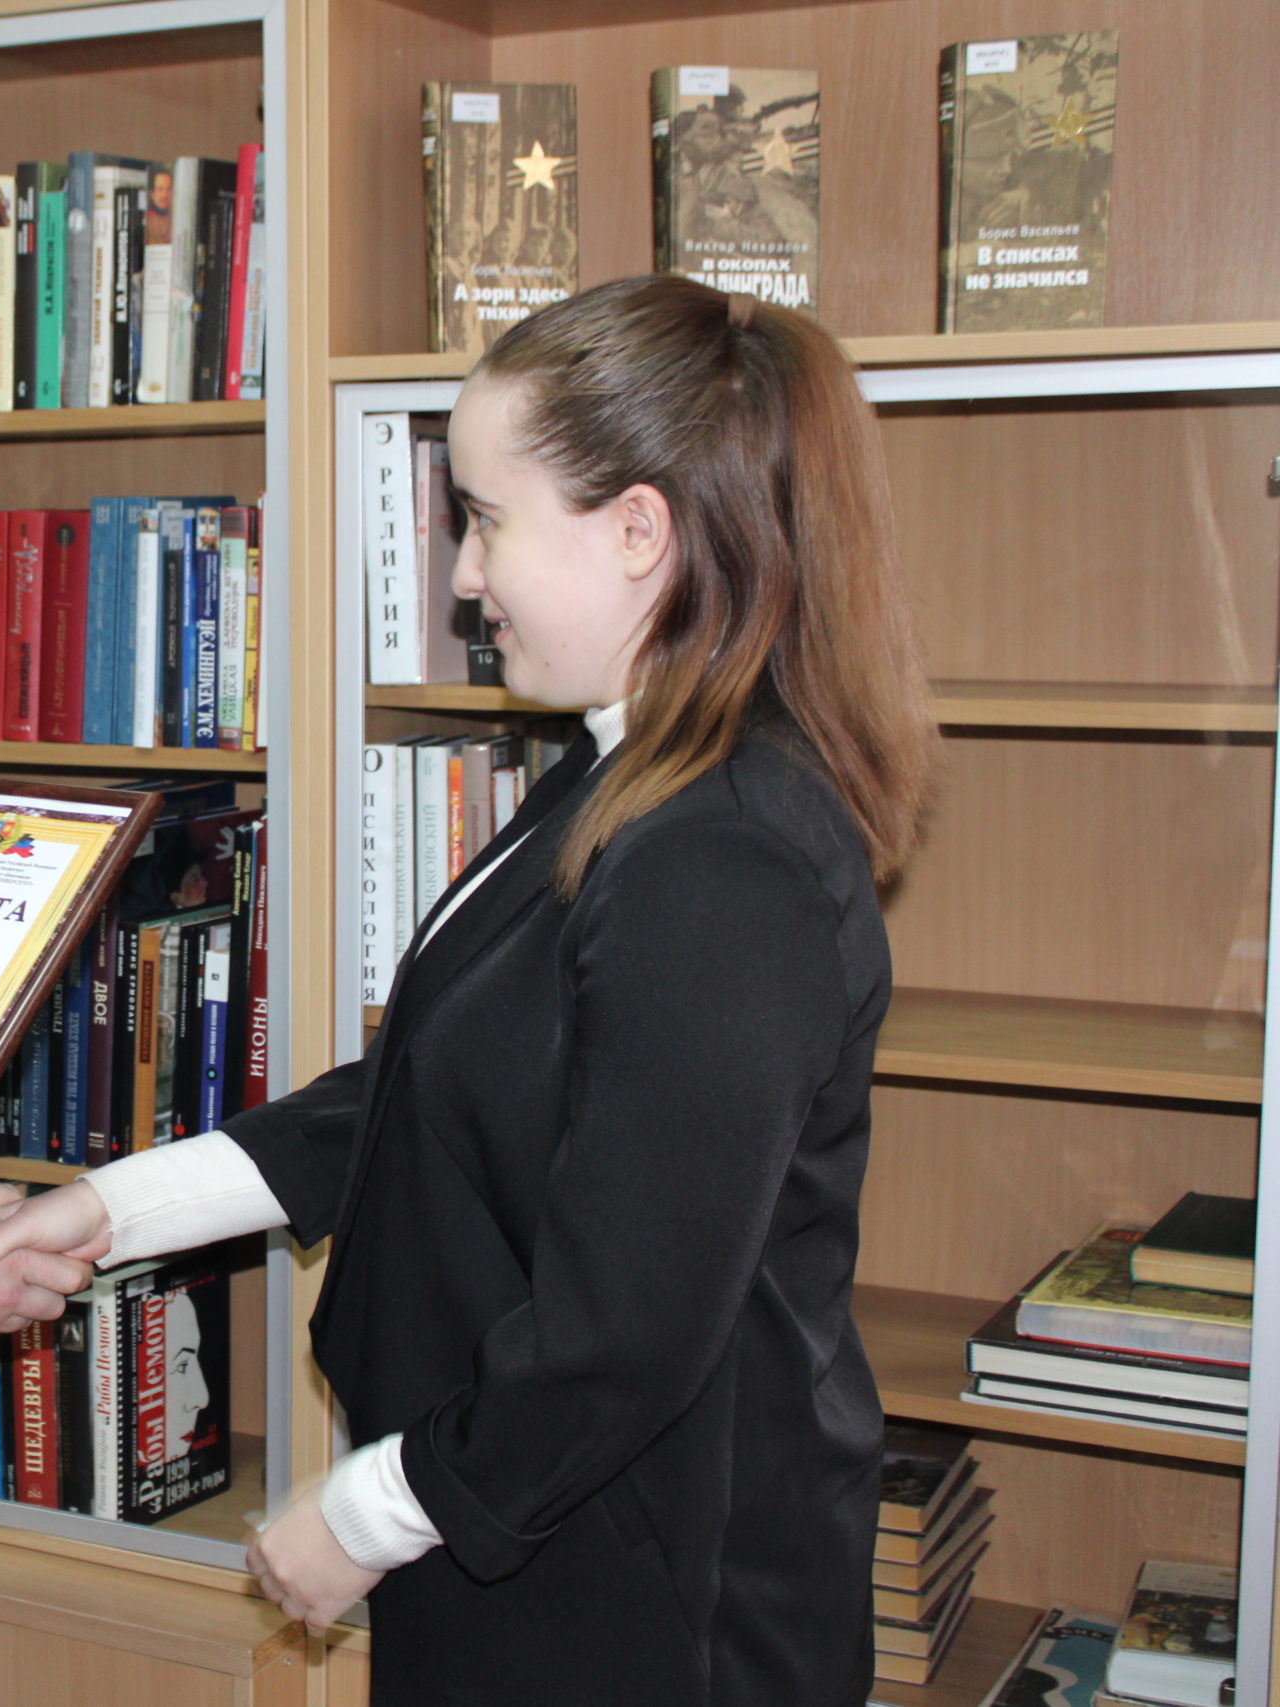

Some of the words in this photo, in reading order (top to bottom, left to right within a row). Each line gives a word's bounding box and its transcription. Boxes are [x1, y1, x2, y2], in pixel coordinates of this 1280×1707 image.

[978, 226, 1017, 241] Борис
[1020, 224, 1081, 238] Васильев
[684, 239, 736, 252] Виктор
[740, 240, 809, 252] Некрасов
[977, 245, 993, 266] В
[995, 245, 1079, 266] списках
[702, 259, 715, 271] В
[717, 258, 791, 271] ОКОПАХ
[965, 273, 991, 290] не
[993, 268, 1089, 288] значился
[454, 283, 468, 301] А
[472, 287, 516, 305] зори
[375, 422, 394, 445] Э
[380, 467, 399, 649] РЕЛИГИЯ
[477, 653, 494, 665] 10
[363, 792, 377, 1002] ПСИХОЛОГИЯ
[93, 980, 108, 1026] ДВОЕ
[127, 975, 136, 1032] ЕРМОЛАЕВ
[68, 1012, 80, 1042] STATE
[250, 996, 268, 1077] ИКОНЫ
[67, 1042, 79, 1080] RUSSIAN
[66, 1081, 77, 1098] THE
[21, 1358, 46, 1474] ШЕДЕВРЫ
[166, 1457, 190, 1485] 1920
